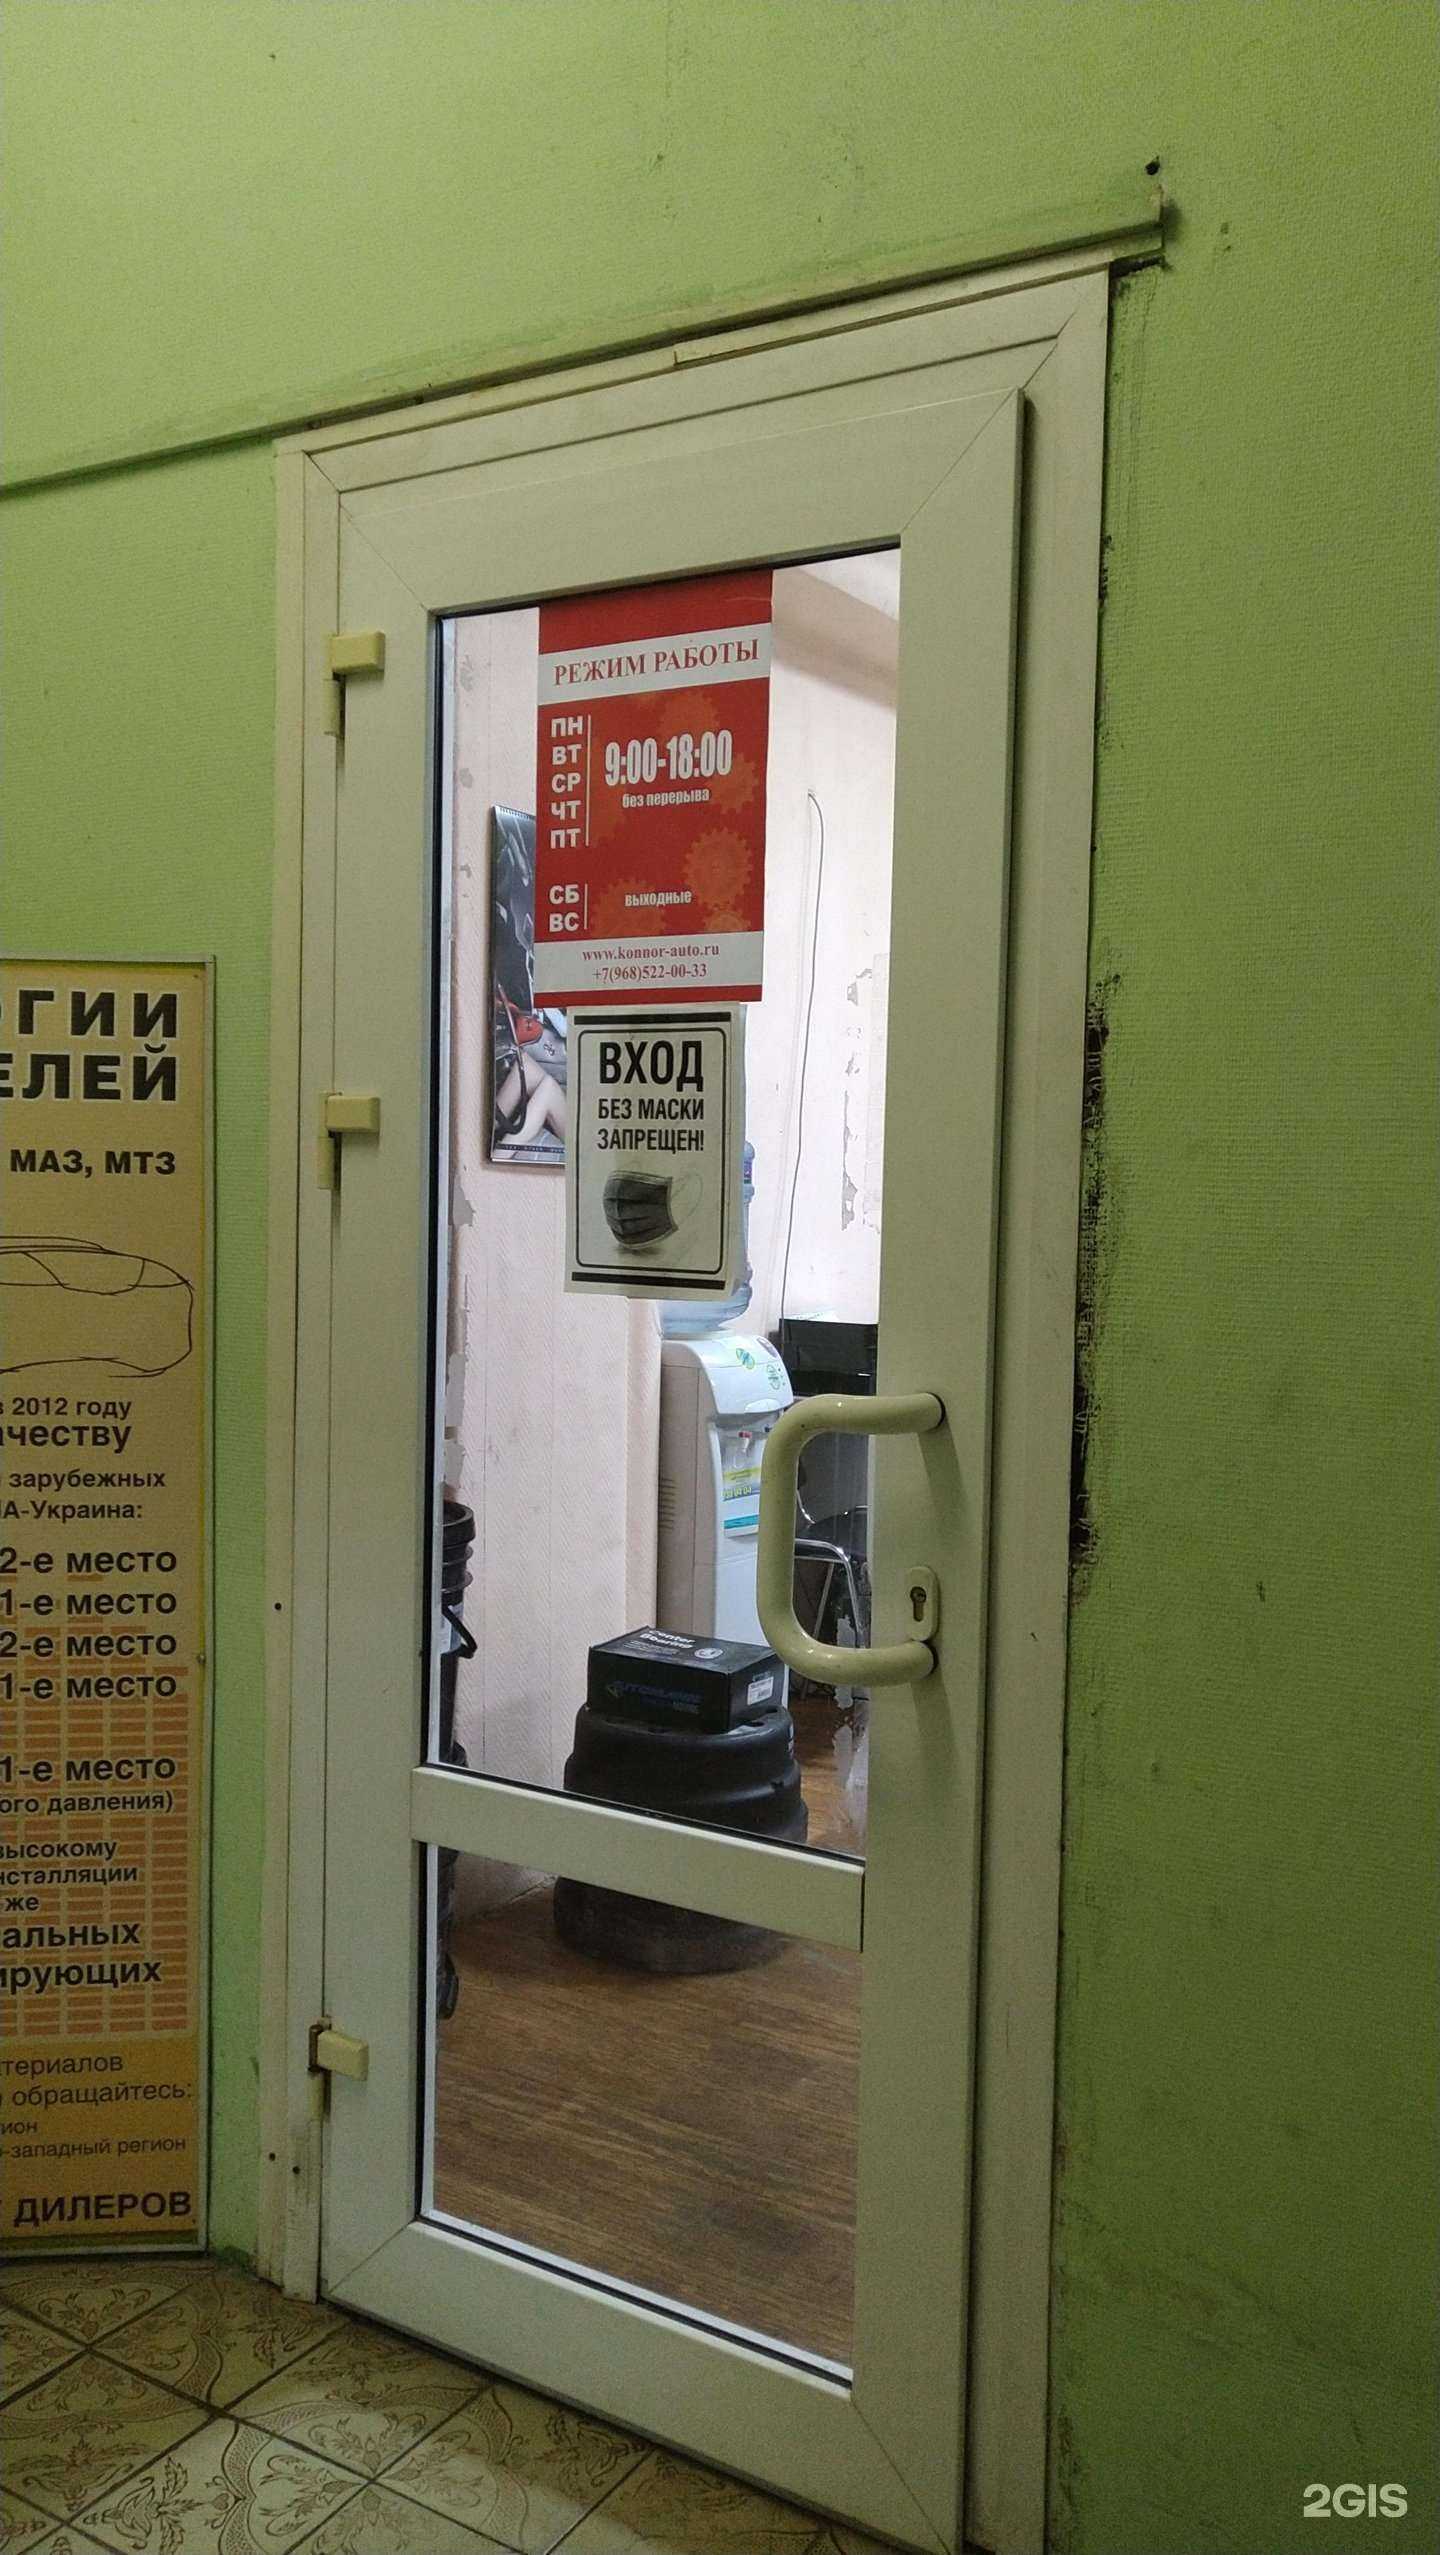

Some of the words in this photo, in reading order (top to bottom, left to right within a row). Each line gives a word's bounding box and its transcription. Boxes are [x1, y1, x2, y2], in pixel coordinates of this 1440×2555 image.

[554, 653, 646, 686] РЕЖИМ
[654, 638, 759, 673] РАБОТЫ
[551, 715, 583, 738] ПН
[552, 743, 582, 765] ВТ
[604, 729, 733, 786] 9:00-18:00
[551, 772, 581, 793] СР
[551, 800, 581, 820] ЧТ
[622, 793, 644, 809] без
[646, 788, 710, 806] перерыва
[550, 828, 581, 849] ПТ
[549, 884, 580, 904] СБ
[624, 890, 693, 907] выходные
[549, 912, 580, 932] ВС
[582, 944, 720, 962] www.konnor-auto.ru
[592, 964, 707, 984] +7(968)522-00-33
[0, 989, 178, 1038] ГИИ
[599, 1040, 704, 1093] ВХОД
[598, 1098, 632, 1120] БЕЗ
[638, 1098, 704, 1120] МАСКИ
[597, 1128, 705, 1155] ЗАПРЕЩЕН!
[10, 1149, 93, 1178] МАЗ,
[105, 1150, 176, 1175] МТЗ
[12, 1397, 68, 1416] 2012
[76, 1401, 132, 1420] году
[0, 1425, 132, 1454] честву
[9, 1468, 166, 1492] зарубежных
[0, 1547, 54, 1574] 2-е
[66, 1550, 177, 1574] место
[0, 1588, 54, 1615] 1-е
[66, 1591, 177, 1615] место
[0, 1630, 54, 1657] 2-е
[66, 1633, 177, 1657] место
[0, 1672, 54, 1699] 1-е
[66, 1675, 177, 1699] место
[0, 1755, 54, 1782] 1-е
[66, 1758, 177, 1782] место
[48, 1790, 173, 1815] давления)
[5, 1896, 39, 1912] же
[3, 1923, 140, 1948] альных
[0, 2055, 123, 2080] териалов
[12, 2082, 192, 2109] обращайтесь:
[0, 2138, 111, 2158] -западный
[118, 2137, 186, 2157] регион
[13, 2190, 192, 2228] ДИЛЕРОВ
